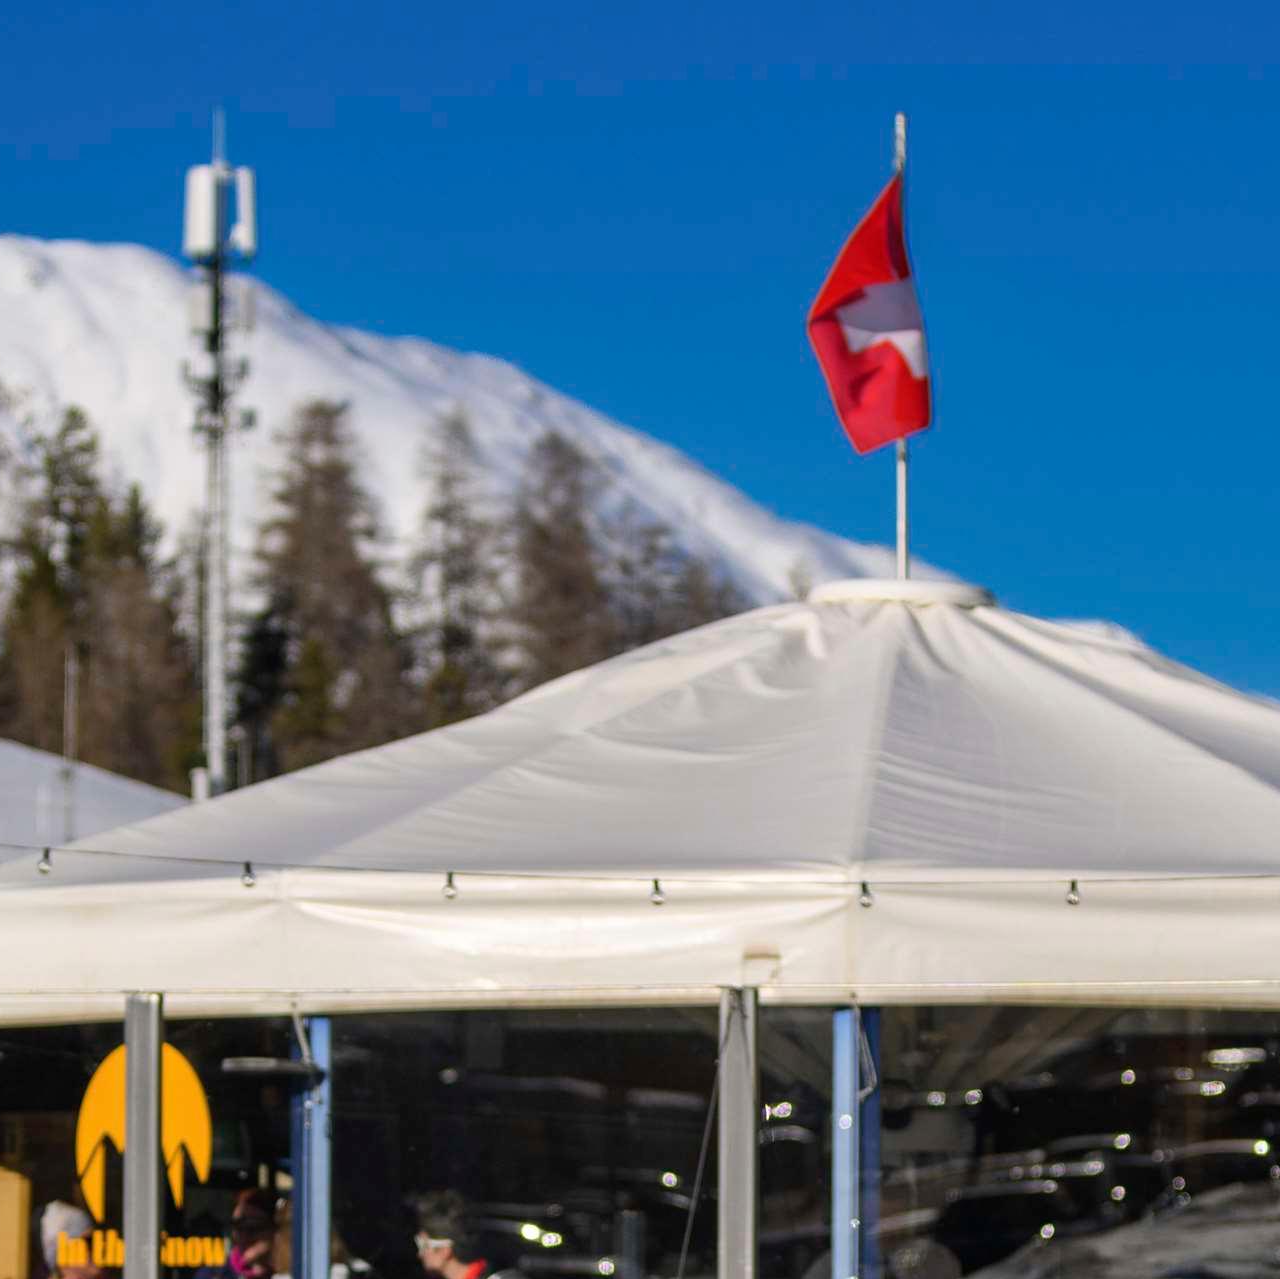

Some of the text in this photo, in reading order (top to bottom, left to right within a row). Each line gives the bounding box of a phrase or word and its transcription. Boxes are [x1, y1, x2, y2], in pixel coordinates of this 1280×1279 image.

[57, 1229, 225, 1267] In th now
